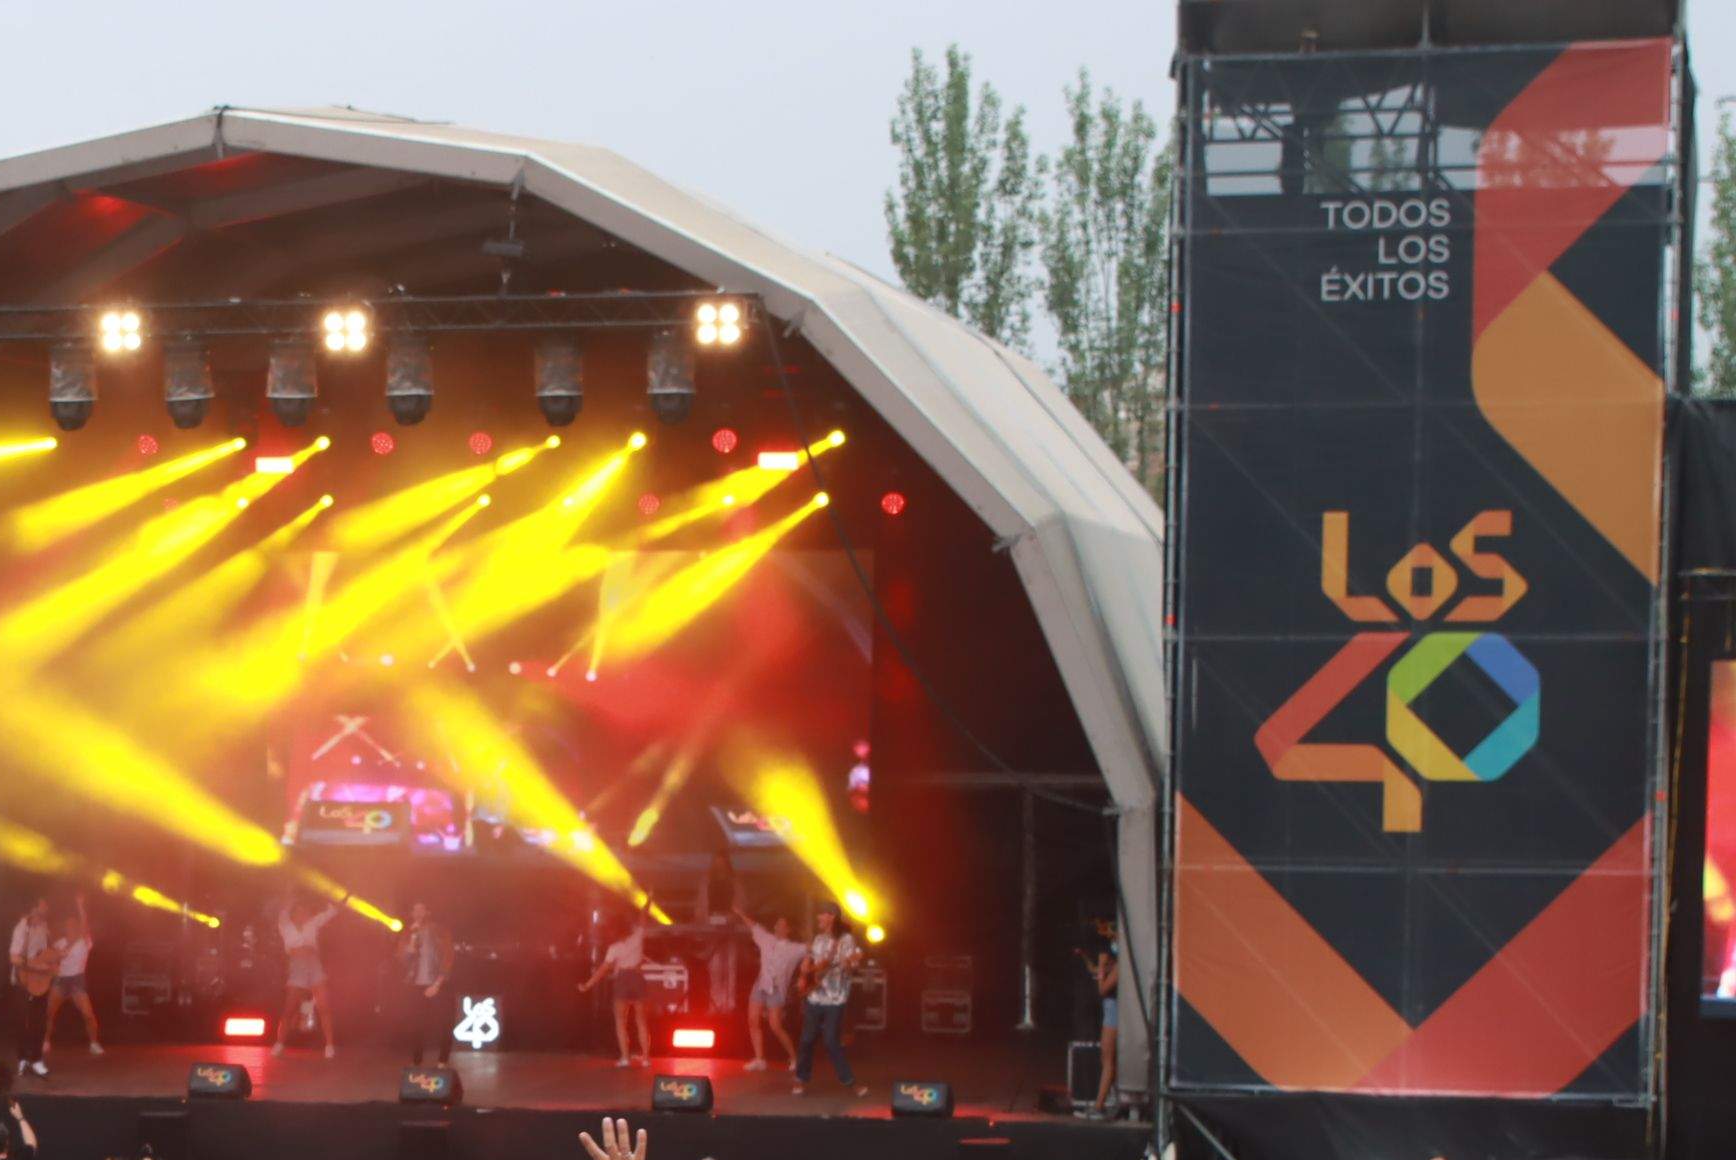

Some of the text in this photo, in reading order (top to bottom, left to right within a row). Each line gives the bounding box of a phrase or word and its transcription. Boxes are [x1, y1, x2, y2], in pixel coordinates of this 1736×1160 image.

[1320, 198, 1451, 230] TODOS
[1378, 234, 1450, 264] LOS
[1321, 265, 1449, 301] ÉXITOS
[1253, 631, 1541, 833] 40
